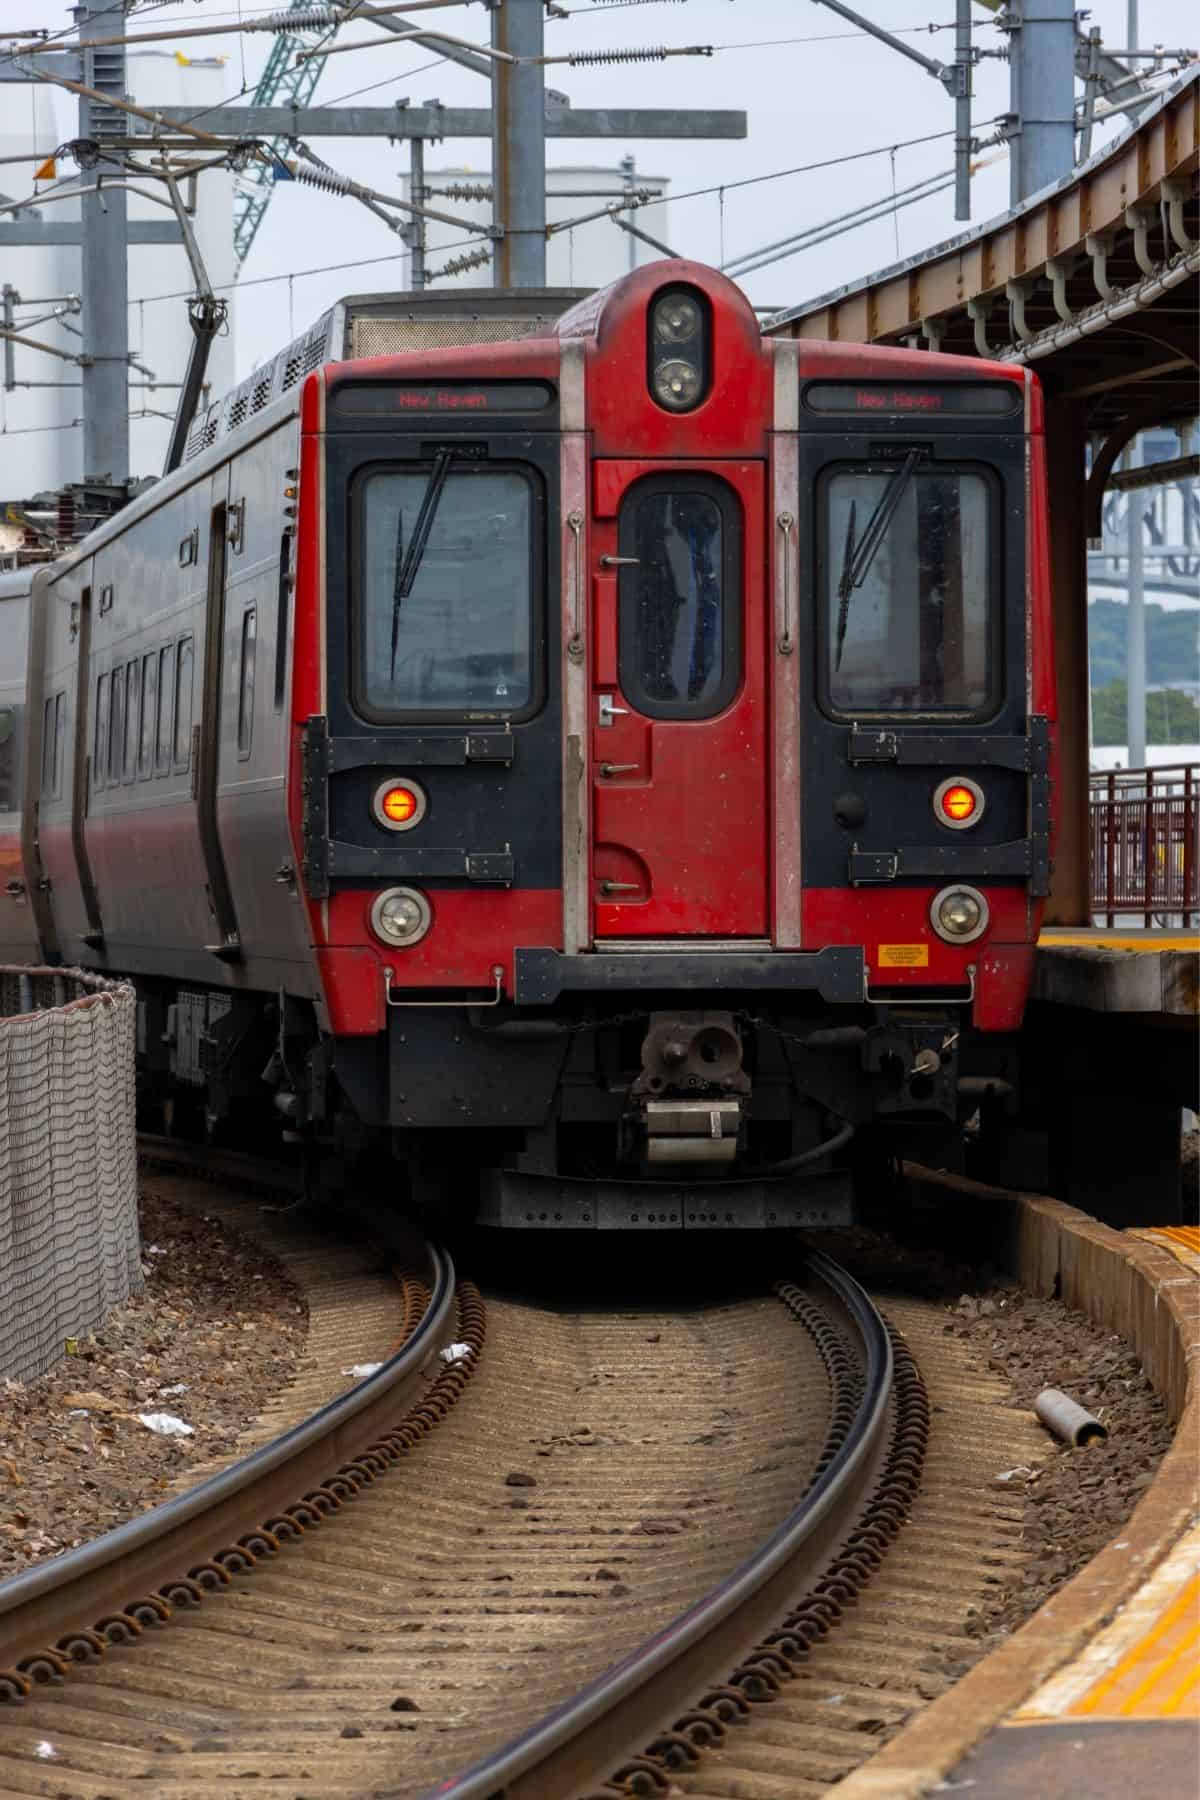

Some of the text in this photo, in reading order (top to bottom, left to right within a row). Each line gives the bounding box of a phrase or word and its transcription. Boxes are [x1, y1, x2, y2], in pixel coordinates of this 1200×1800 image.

[400, 392, 487, 409] New Haven
[856, 392, 942, 409] New Haven
